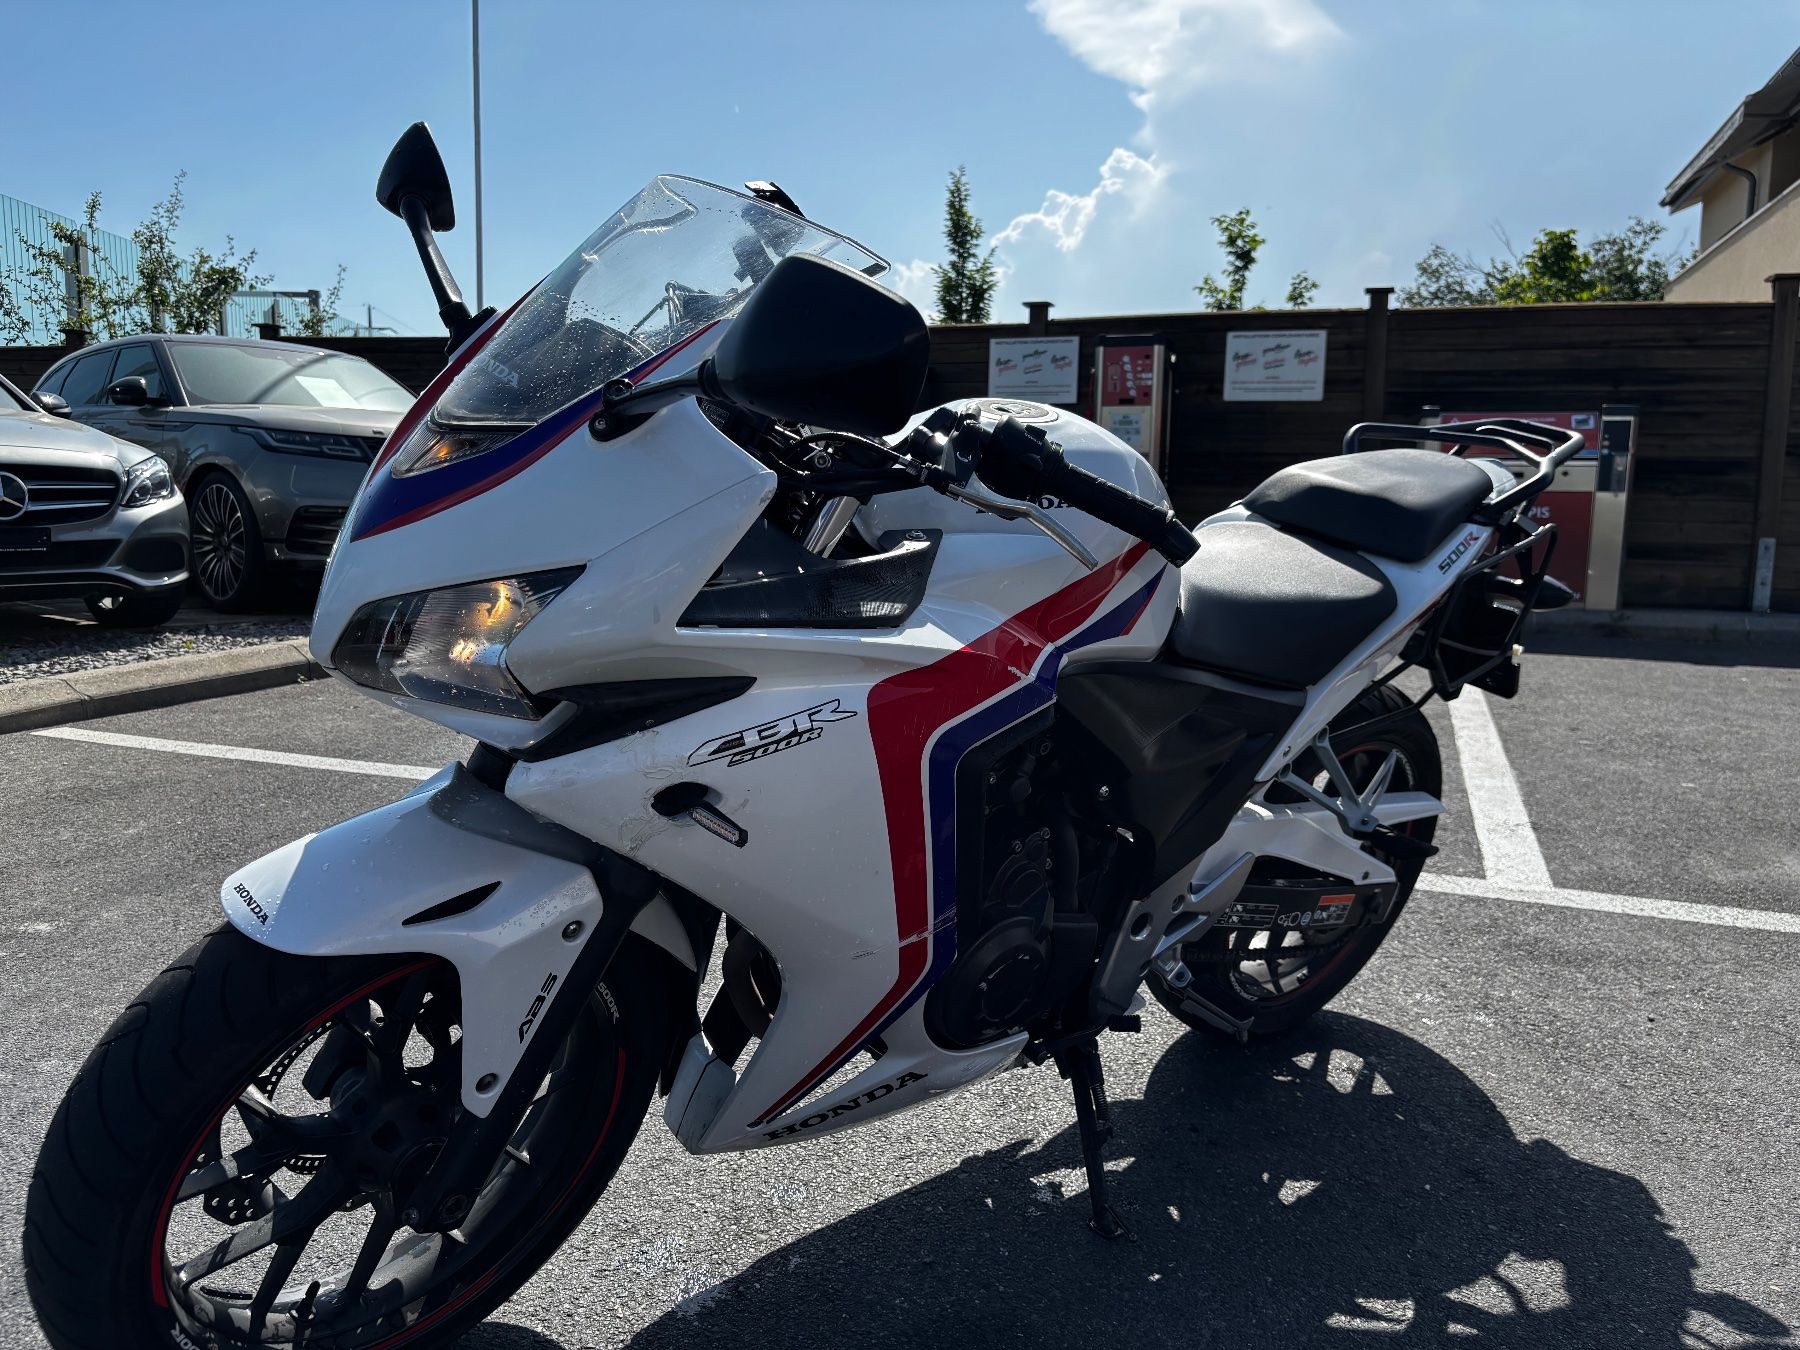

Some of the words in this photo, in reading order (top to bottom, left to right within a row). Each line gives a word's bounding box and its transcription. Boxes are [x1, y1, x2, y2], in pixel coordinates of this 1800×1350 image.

[1438, 530, 1480, 575] 500R
[687, 699, 858, 767] CBR
[727, 726, 824, 768] 500R
[233, 882, 270, 926] HONDA
[518, 971, 558, 1045] ABS
[597, 981, 620, 1025] 500R
[762, 1071, 929, 1142] HONDA
